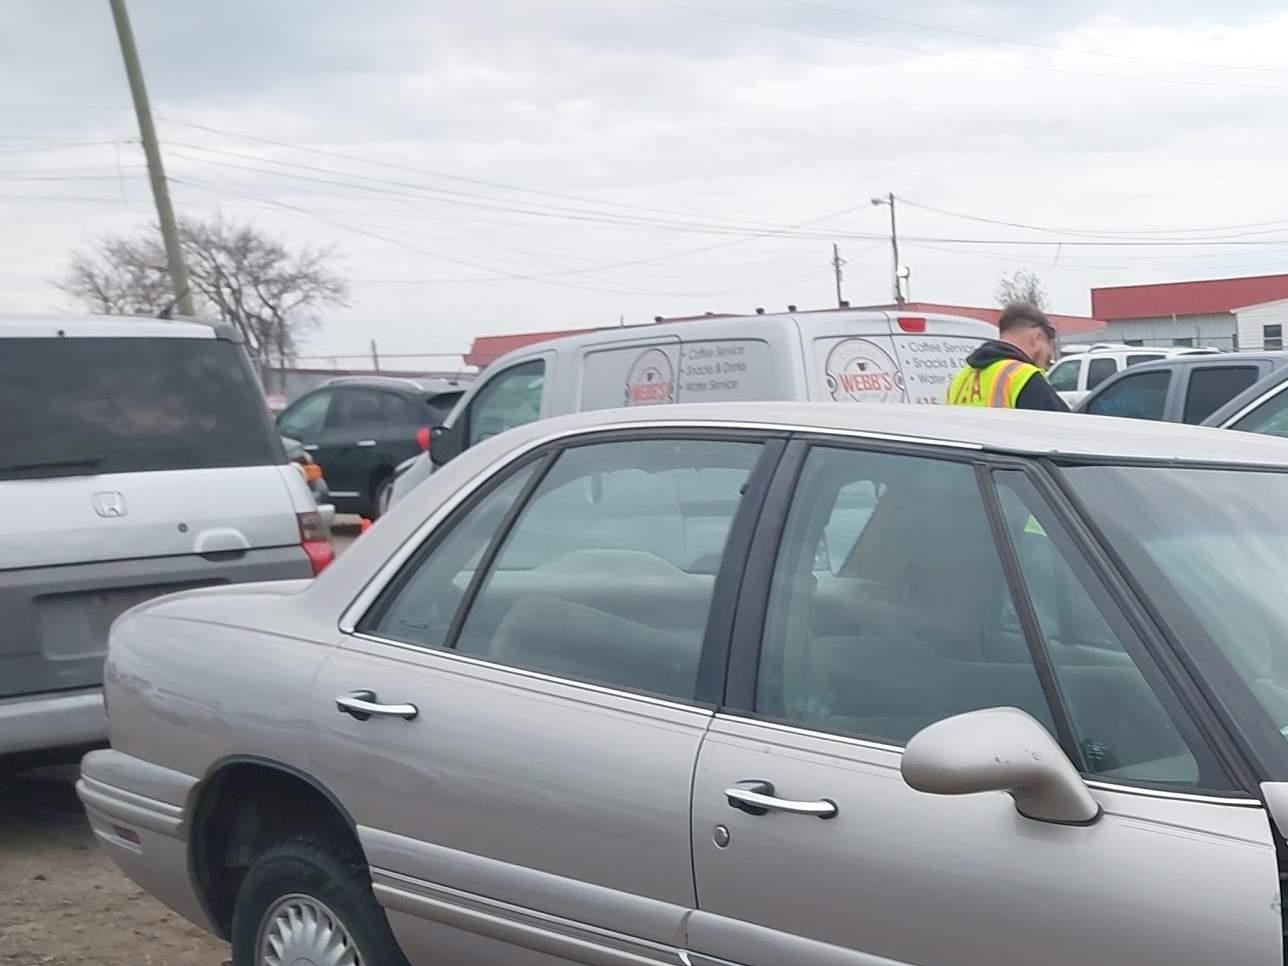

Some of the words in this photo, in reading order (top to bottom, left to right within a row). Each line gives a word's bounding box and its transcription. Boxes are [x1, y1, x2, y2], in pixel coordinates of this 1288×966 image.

[908, 342, 942, 353] Coffee
[913, 357, 948, 368] Snacks
[838, 371, 892, 394] WEBB'S
[917, 373, 945, 384] Water
